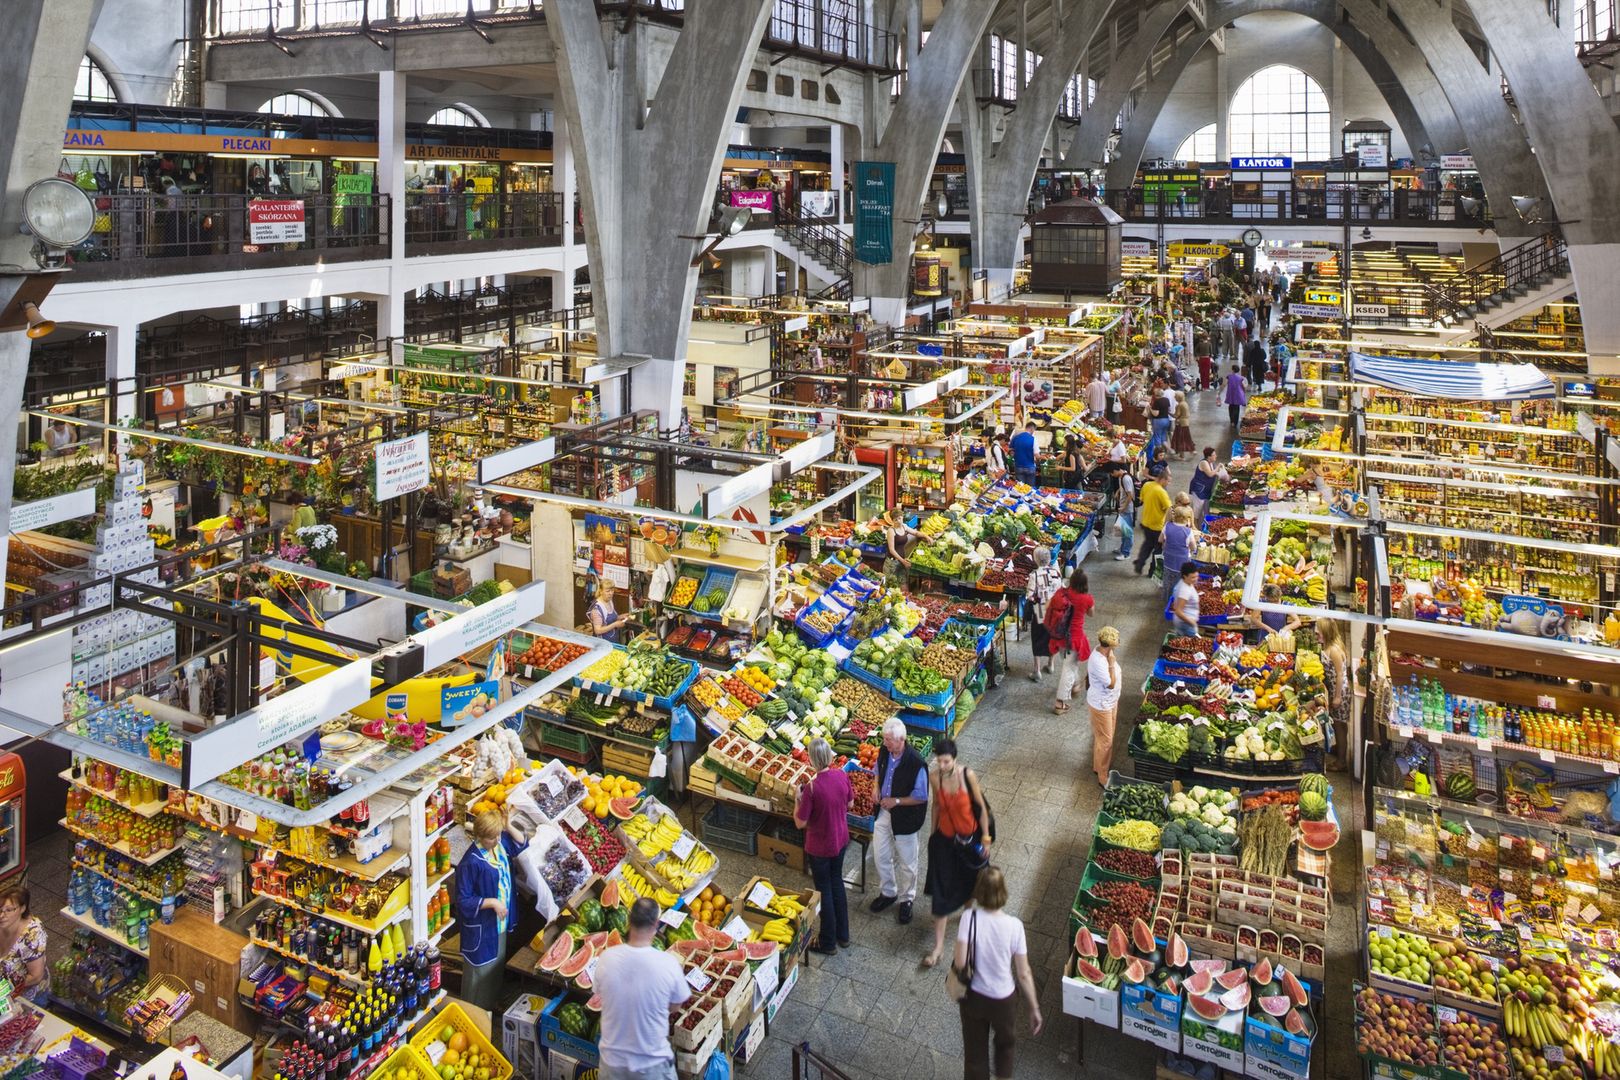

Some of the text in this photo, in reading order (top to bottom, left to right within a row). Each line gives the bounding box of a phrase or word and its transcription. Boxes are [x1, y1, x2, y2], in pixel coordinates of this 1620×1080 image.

[222, 138, 271, 151] PLECAKI
[410, 145, 500, 159] ART. ORIENTALNE
[1238, 159, 1284, 167] KANTOR
[254, 204, 301, 212] GALANTERIA
[258, 212, 297, 221] SKÓRZANA
[1183, 247, 1220, 256] ALKOHOLE
[1308, 293, 1338, 302] LOTTO
[444, 686, 482, 701] SWEETY
[257, 714, 318, 749] Czesława ADAMIUK
[271, 720, 294, 734] stoisko
